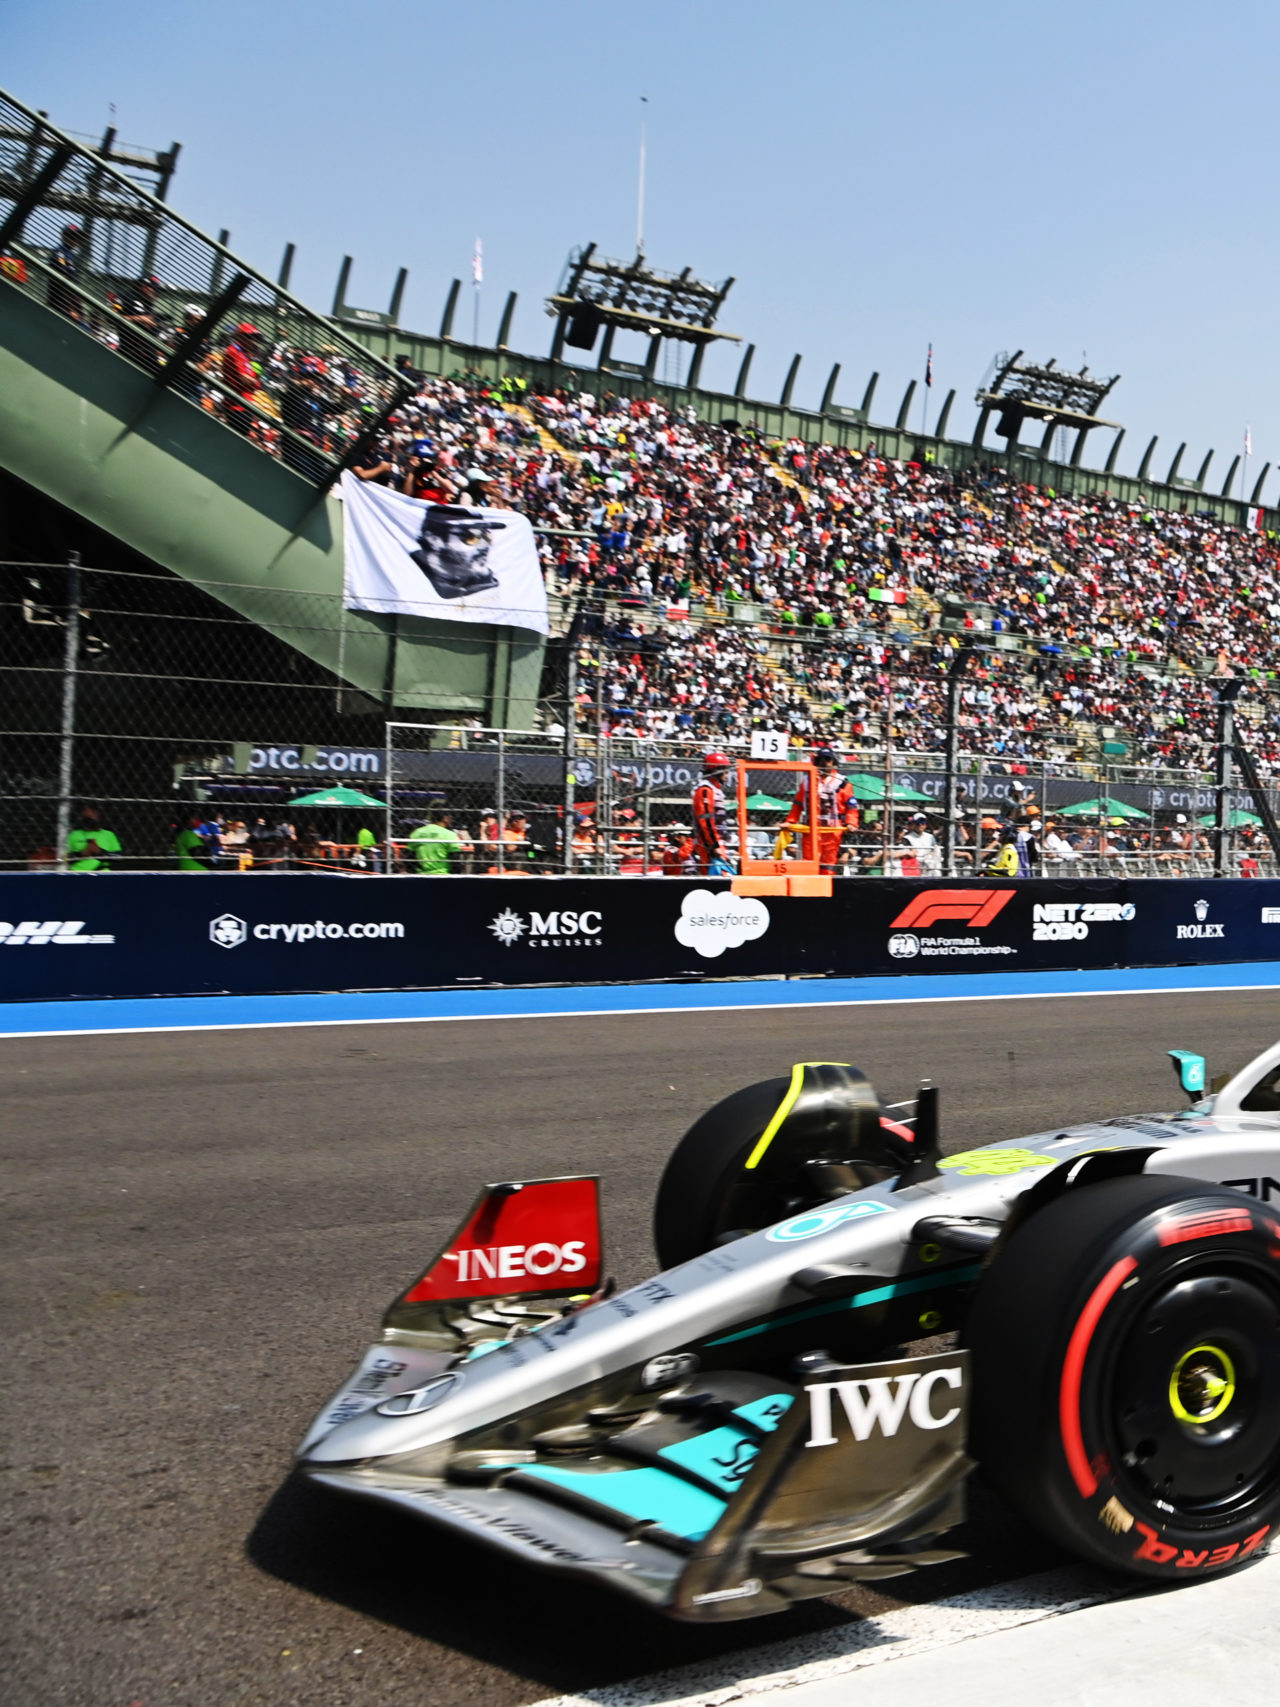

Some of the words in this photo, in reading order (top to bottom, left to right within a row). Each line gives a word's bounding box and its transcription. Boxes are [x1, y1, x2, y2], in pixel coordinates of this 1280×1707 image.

[761, 738, 778, 753] 15
[690, 912, 759, 929] salesforce
[1033, 903, 1079, 922] NET
[1080, 903, 1136, 921] ZERO
[253, 920, 404, 943] crypto.com
[528, 911, 602, 935] MSC
[1033, 921, 1089, 940] 2030
[1176, 924, 1225, 939] ROLEX
[528, 938, 602, 948] CRUISES
[456, 1241, 586, 1282] INEOS
[803, 1367, 963, 1448] IWC
